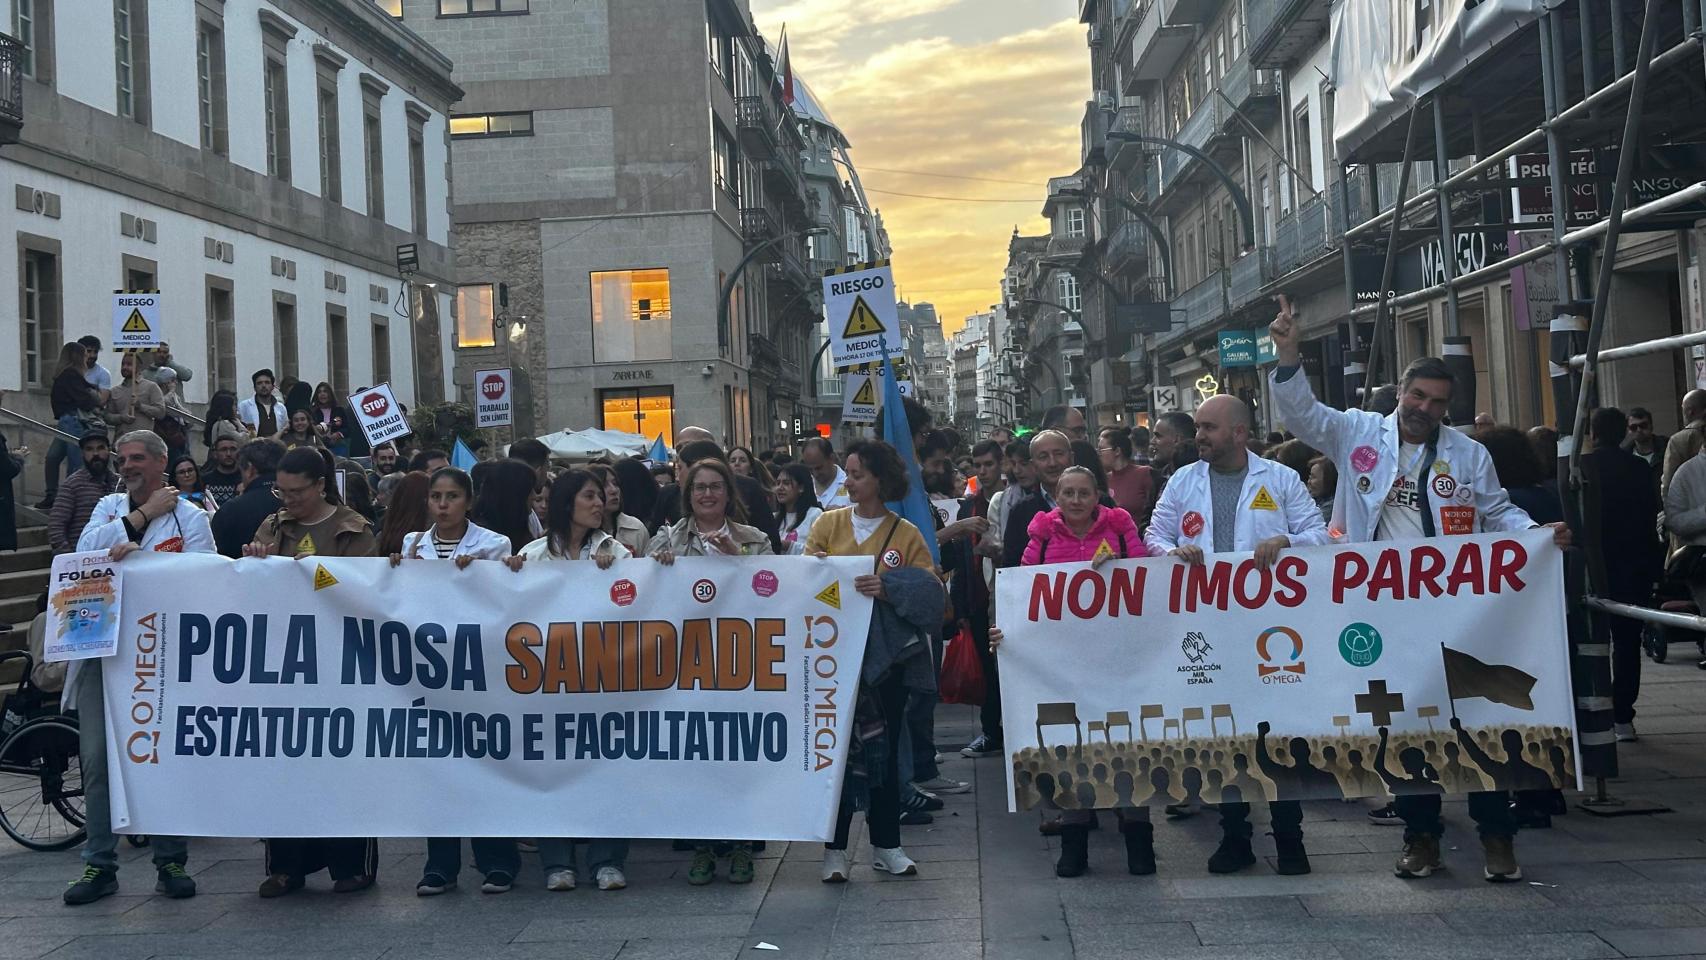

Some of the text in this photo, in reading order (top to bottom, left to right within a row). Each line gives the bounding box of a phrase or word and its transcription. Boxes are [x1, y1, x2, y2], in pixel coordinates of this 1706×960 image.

[831, 275, 884, 296] RIESGO
[1357, 290, 1396, 300] MANO
[118, 298, 155, 306] RIESGO
[842, 353, 859, 362] HORA
[866, 350, 874, 358] DE
[483, 382, 504, 393] STOP
[362, 398, 386, 413] STOP
[479, 403, 509, 412] TRABALLO
[366, 414, 400, 432] TRABALLO
[371, 422, 405, 441] SEN LÍMITE
[1437, 480, 1453, 491] 30
[1183, 513, 1196, 527] STOP
[884, 551, 900, 566] 30
[59, 567, 115, 583] FOLGA
[1028, 539, 1528, 622] NON IMOS PARAR
[614, 583, 631, 591] STOP
[698, 585, 713, 596] 30
[178, 613, 787, 694] POLA NOSA SANIDADE
[1177, 663, 1221, 673] ASOCIACIÓN
[1187, 677, 1213, 685] ESPAÑA
[175, 696, 788, 762] ESTATUTO MÉDICO E FACULTATIVO
